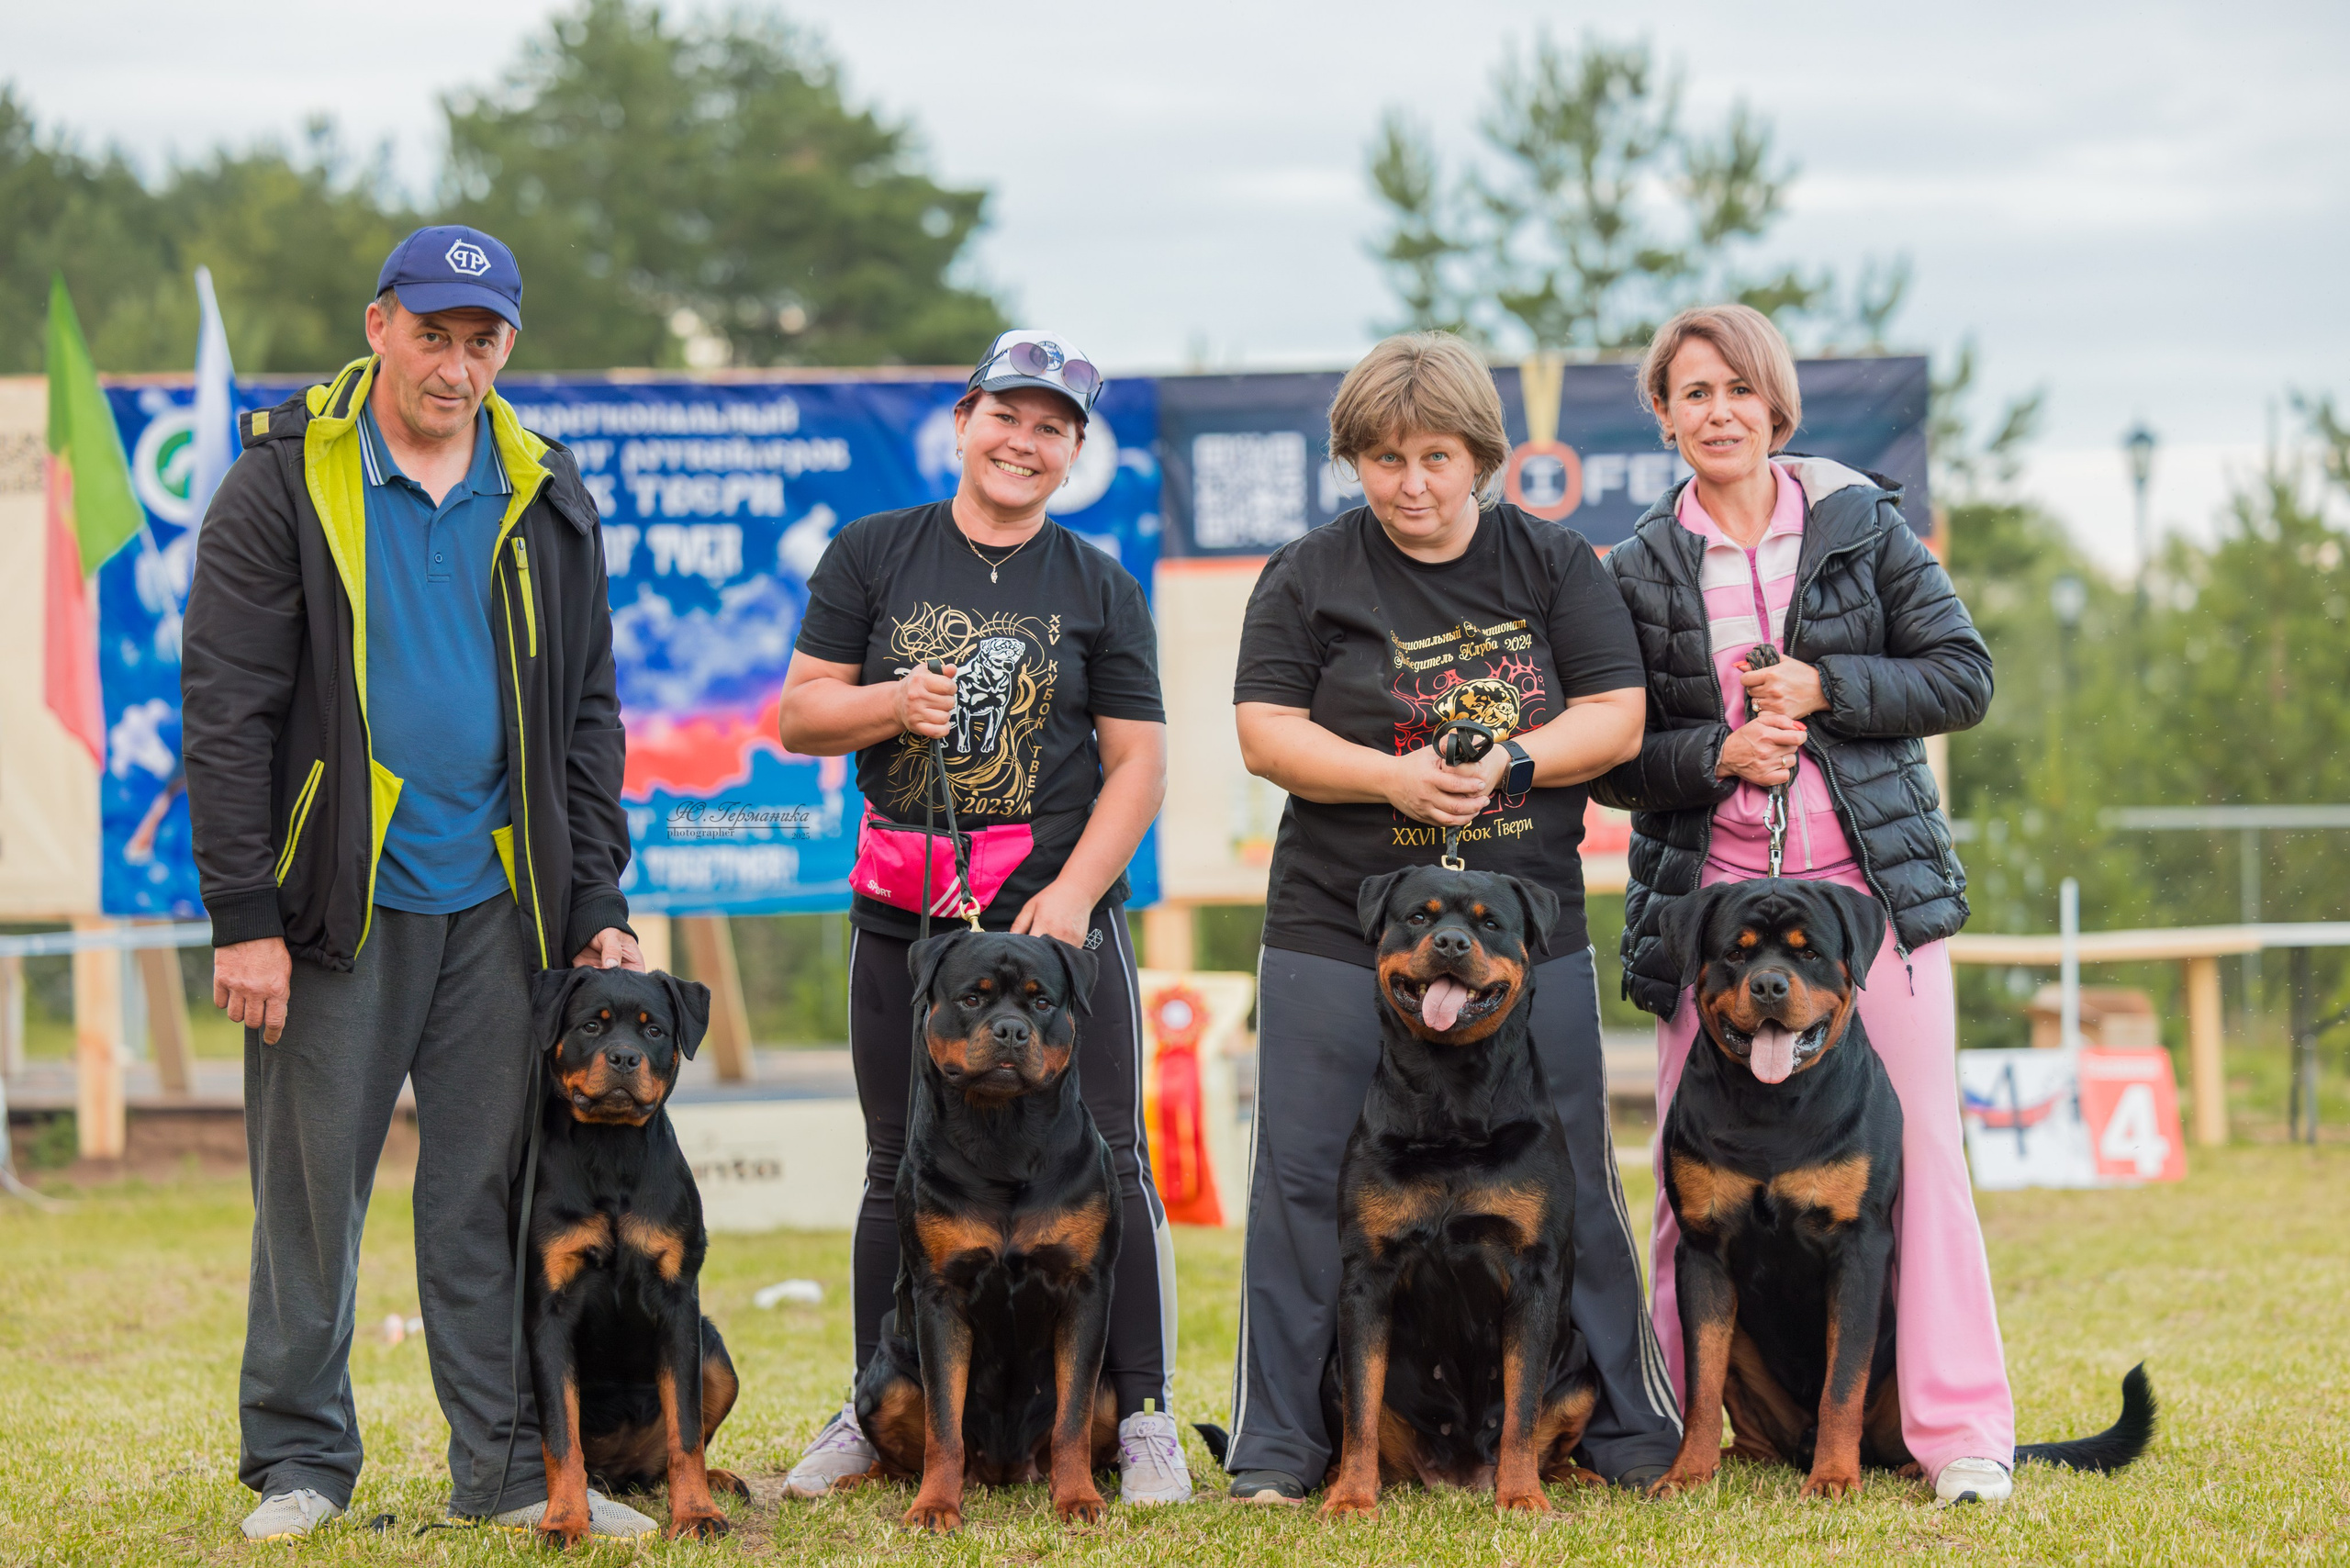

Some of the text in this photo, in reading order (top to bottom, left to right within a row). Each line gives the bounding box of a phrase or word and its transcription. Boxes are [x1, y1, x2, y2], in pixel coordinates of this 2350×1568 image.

[1463, 619, 1528, 638] Чмпионат
[1459, 637, 1498, 661] Клуба
[1505, 633, 1532, 652] 2024
[1034, 659, 1058, 730] КУБОК
[961, 796, 1015, 816] 2023
[1392, 827, 1436, 846] XXVI
[1494, 817, 1534, 839] Твери
[2098, 1082, 2172, 1178] 4
